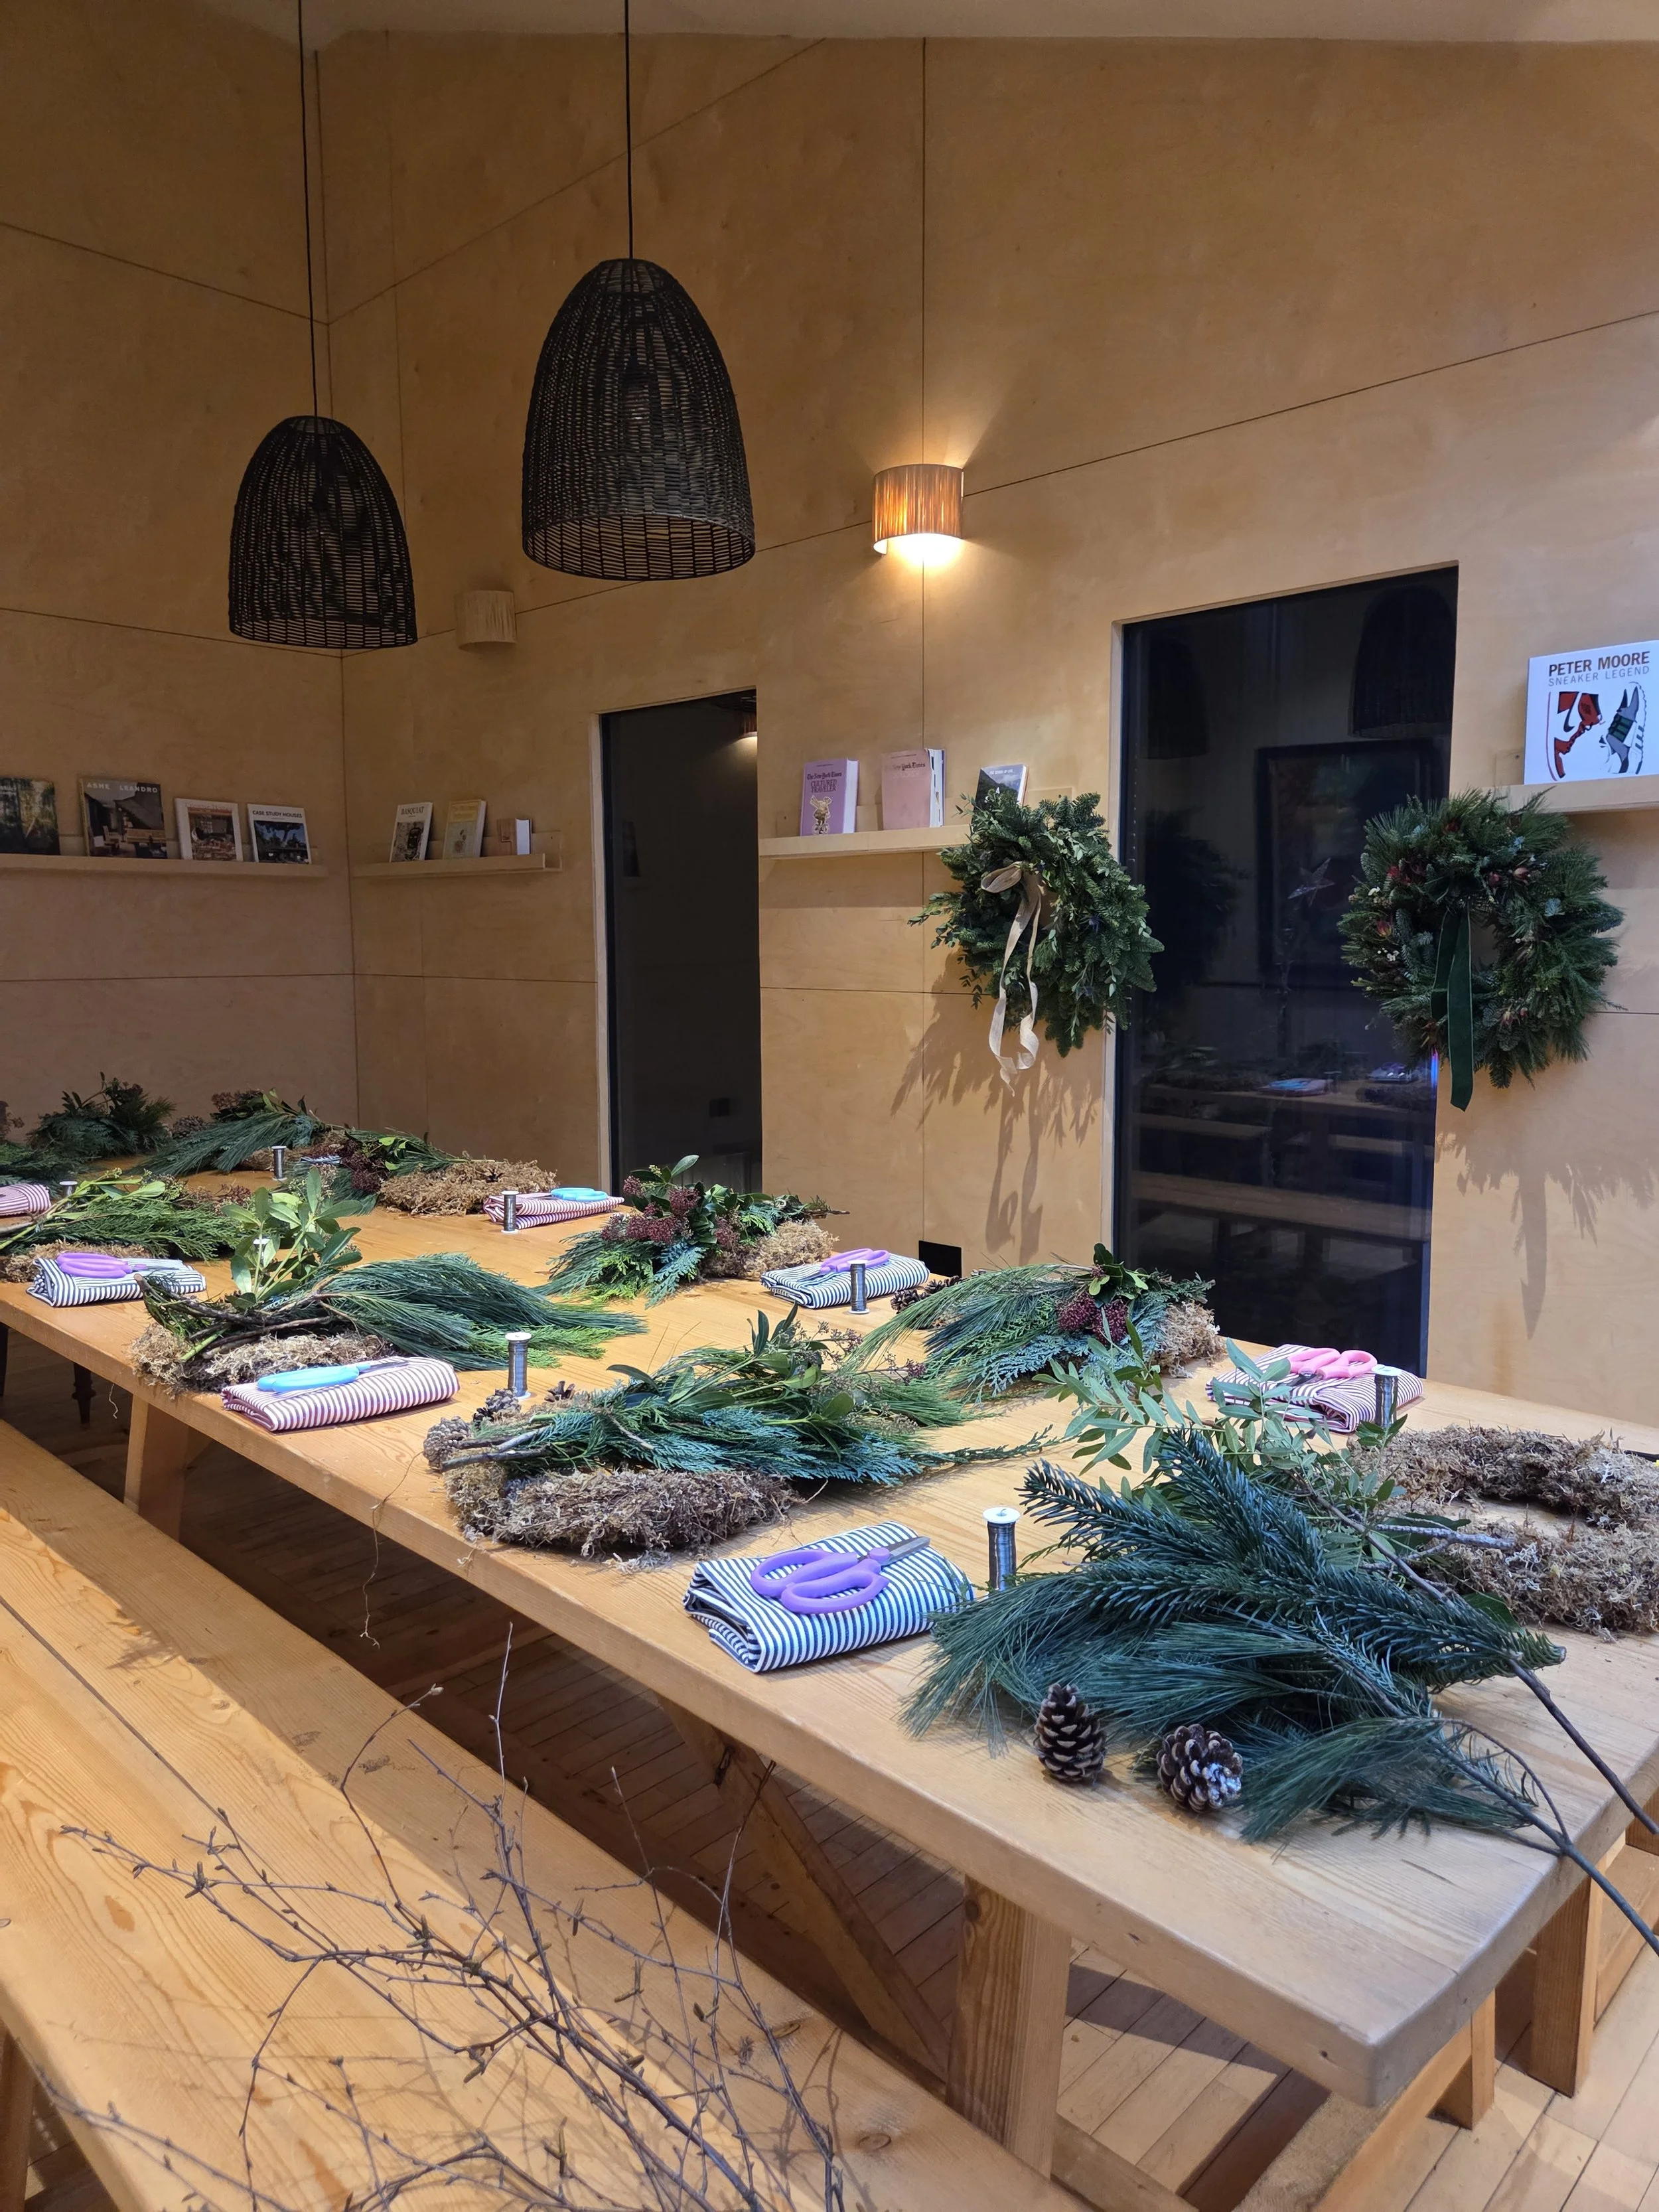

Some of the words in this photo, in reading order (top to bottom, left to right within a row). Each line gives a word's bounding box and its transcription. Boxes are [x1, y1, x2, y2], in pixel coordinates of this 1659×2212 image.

[1548, 658, 1592, 677] PETER
[1597, 650, 1651, 671] MOORE
[1548, 672, 1599, 687] SNEAKER
[1605, 666, 1650, 680] LEGEND
[901, 763, 912, 771] York
[119, 784, 158, 793] LEANDRO
[401, 806, 425, 816] BASQUIAT
